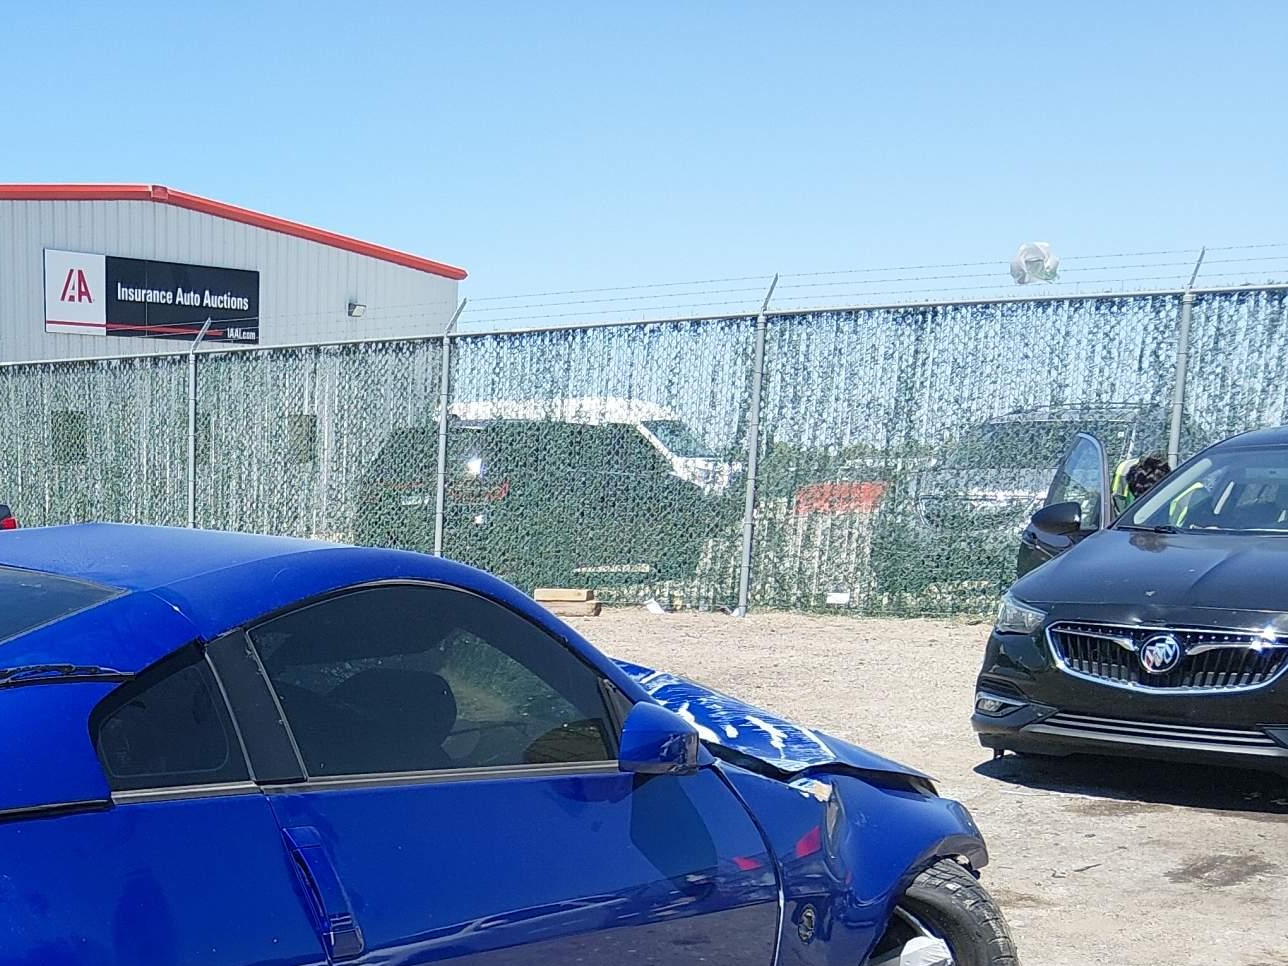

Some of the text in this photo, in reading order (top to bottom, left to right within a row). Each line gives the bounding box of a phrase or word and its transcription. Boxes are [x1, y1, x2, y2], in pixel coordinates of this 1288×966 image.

[117, 282, 249, 311] Insurance Auto Auctions
